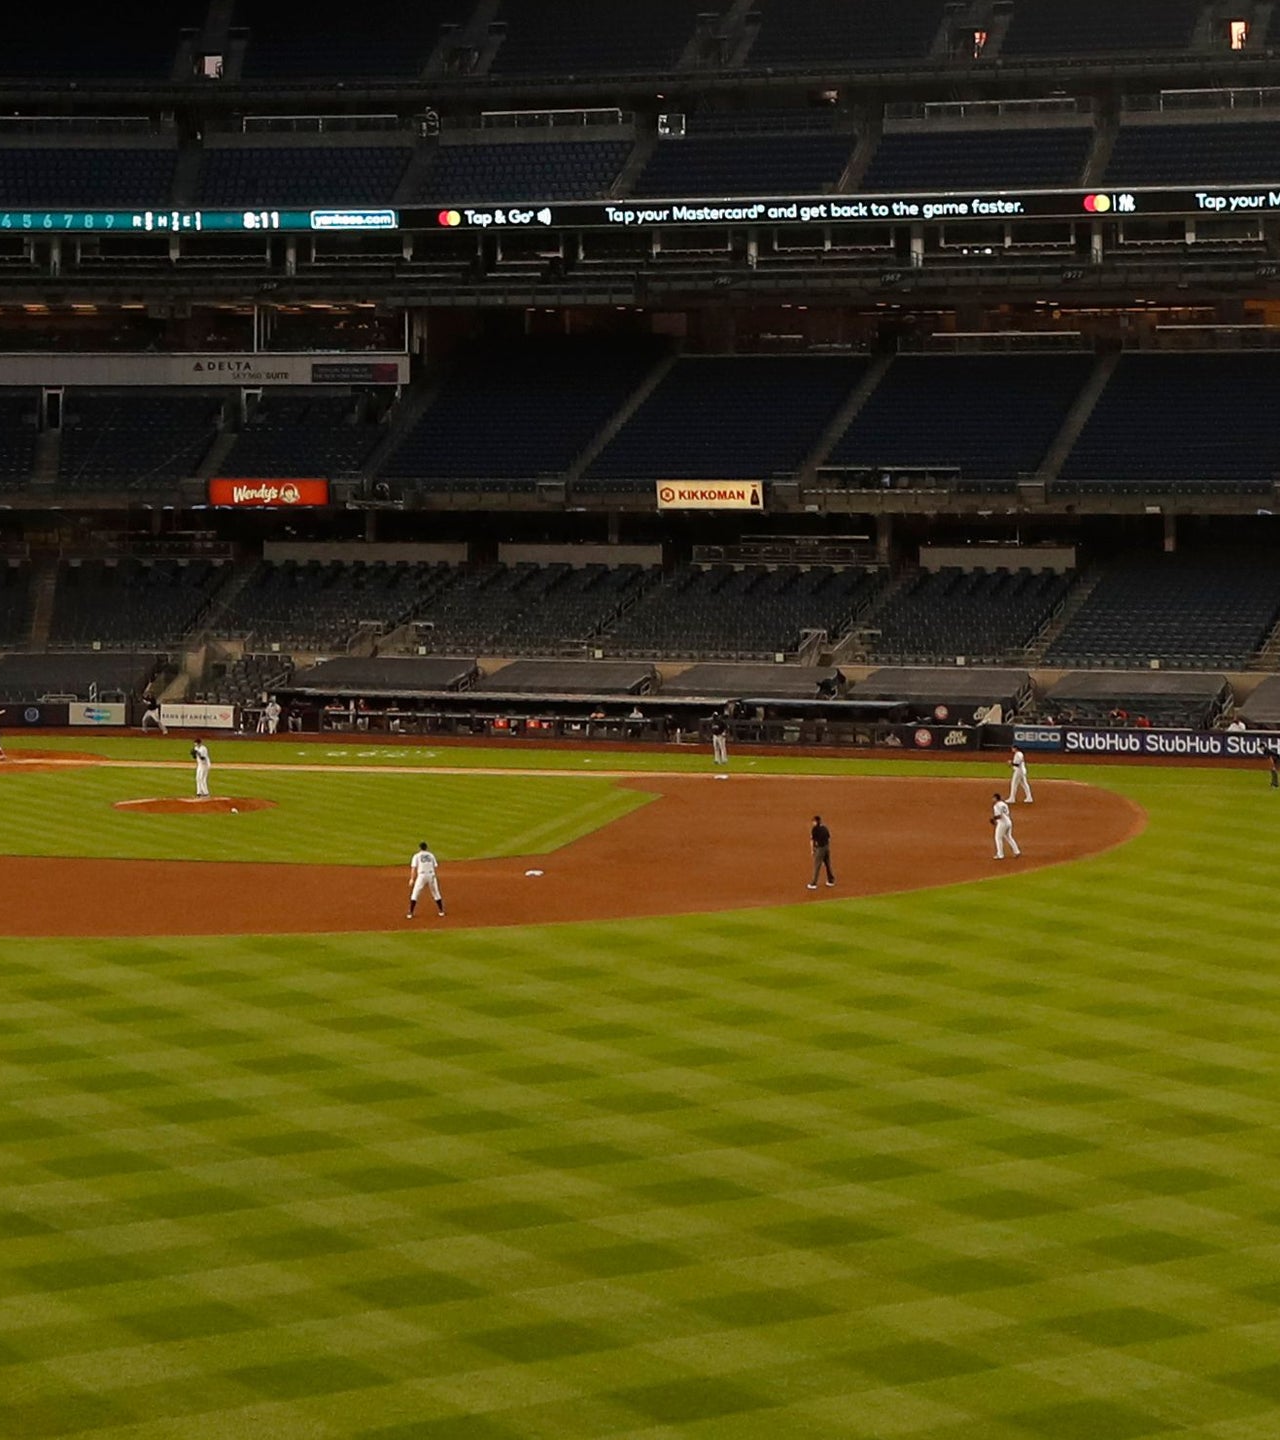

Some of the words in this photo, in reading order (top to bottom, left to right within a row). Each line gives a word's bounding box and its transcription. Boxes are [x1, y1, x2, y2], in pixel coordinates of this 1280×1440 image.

[1195, 192, 1227, 211] Tap
[1230, 194, 1266, 211] your
[243, 211, 279, 229] 8:11
[464, 210, 492, 227] Tap
[494, 209, 507, 224] &
[605, 207, 632, 224] Tap
[636, 210, 669, 224] your
[768, 203, 797, 219] and
[800, 204, 825, 221] get
[830, 202, 868, 218] back
[870, 203, 889, 217] to
[892, 201, 919, 216] the
[923, 203, 968, 219] game
[972, 198, 1024, 214] faster.
[1, 214, 12, 228] 4
[23, 214, 32, 228] 5
[43, 214, 53, 228] 6
[64, 214, 73, 228] 7
[84, 214, 94, 228] 8
[105, 214, 115, 228] 9
[207, 361, 252, 371] DELTA
[233, 484, 278, 503] Wendy's
[678, 489, 745, 501] KIKKOMAN
[1014, 731, 1062, 742] GEICO
[1065, 731, 1141, 752] StubHub
[1145, 733, 1221, 754] StubHub
